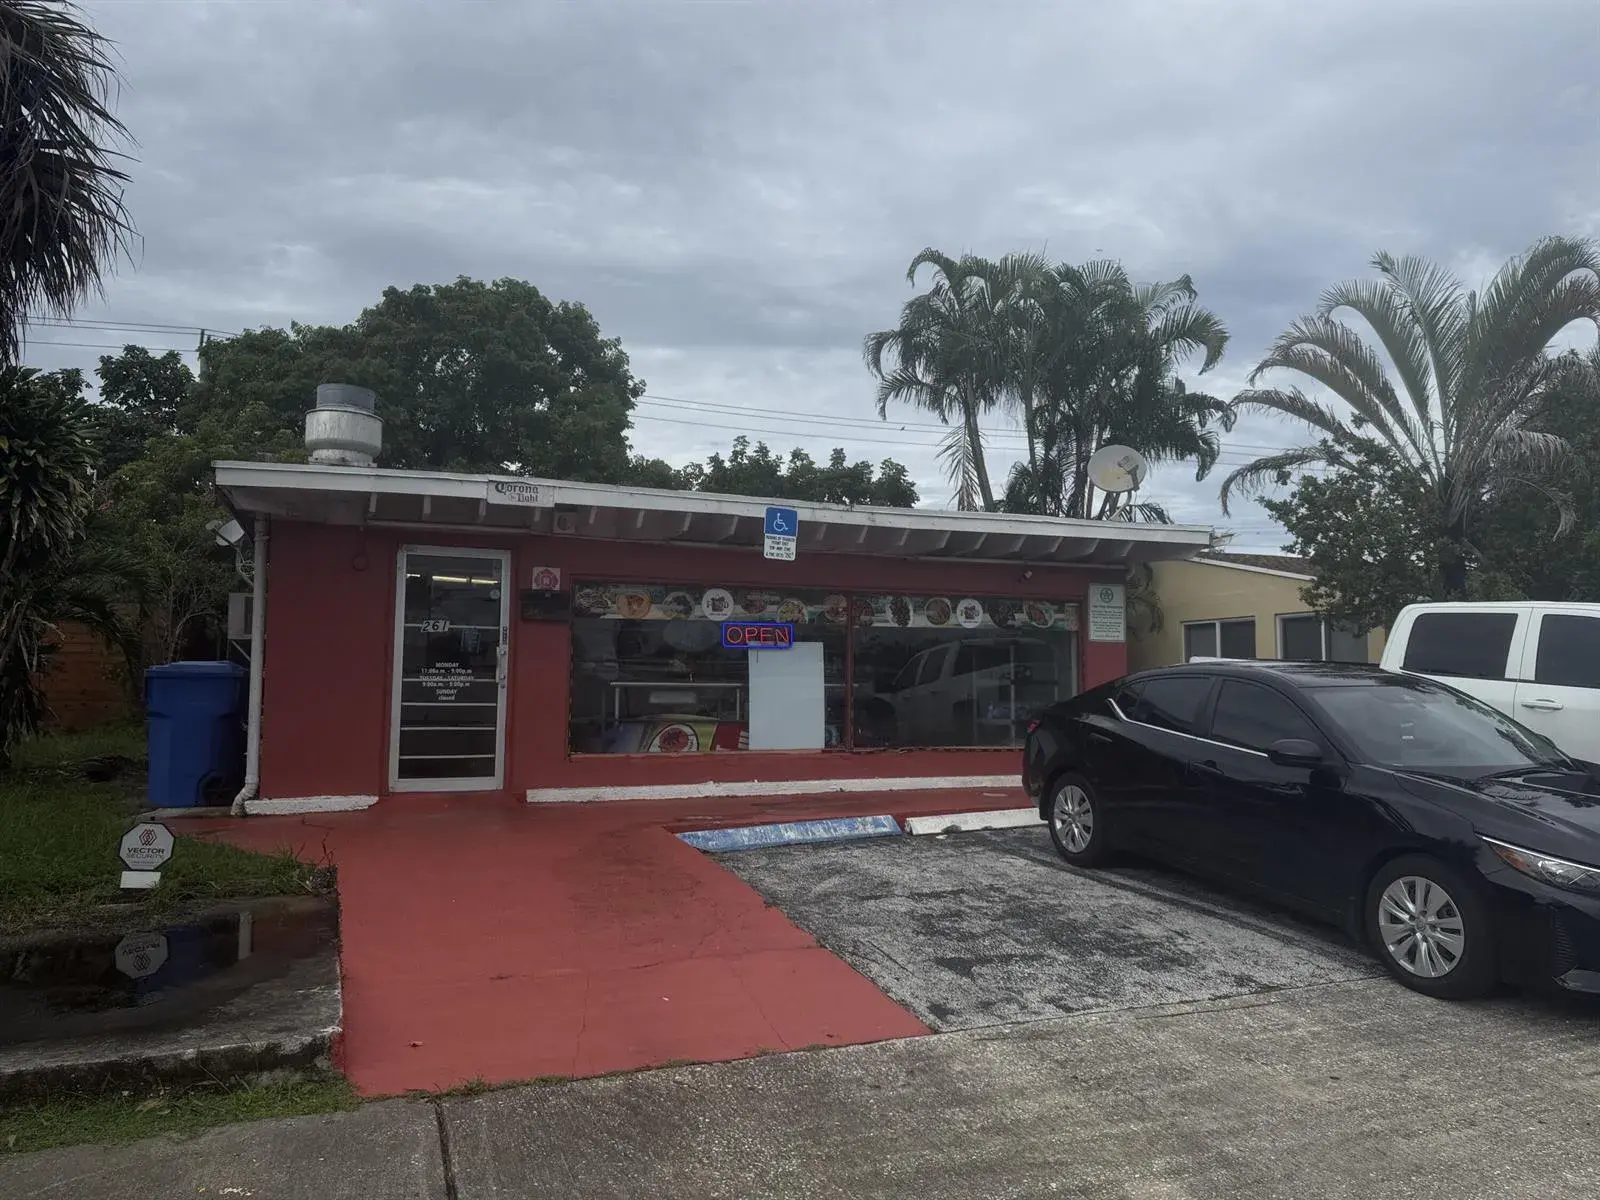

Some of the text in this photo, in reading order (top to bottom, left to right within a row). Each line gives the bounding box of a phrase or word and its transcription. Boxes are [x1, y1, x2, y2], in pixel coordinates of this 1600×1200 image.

[495, 482, 539, 495] Corona
[423, 621, 447, 632] 261
[726, 626, 789, 644] OPEN
